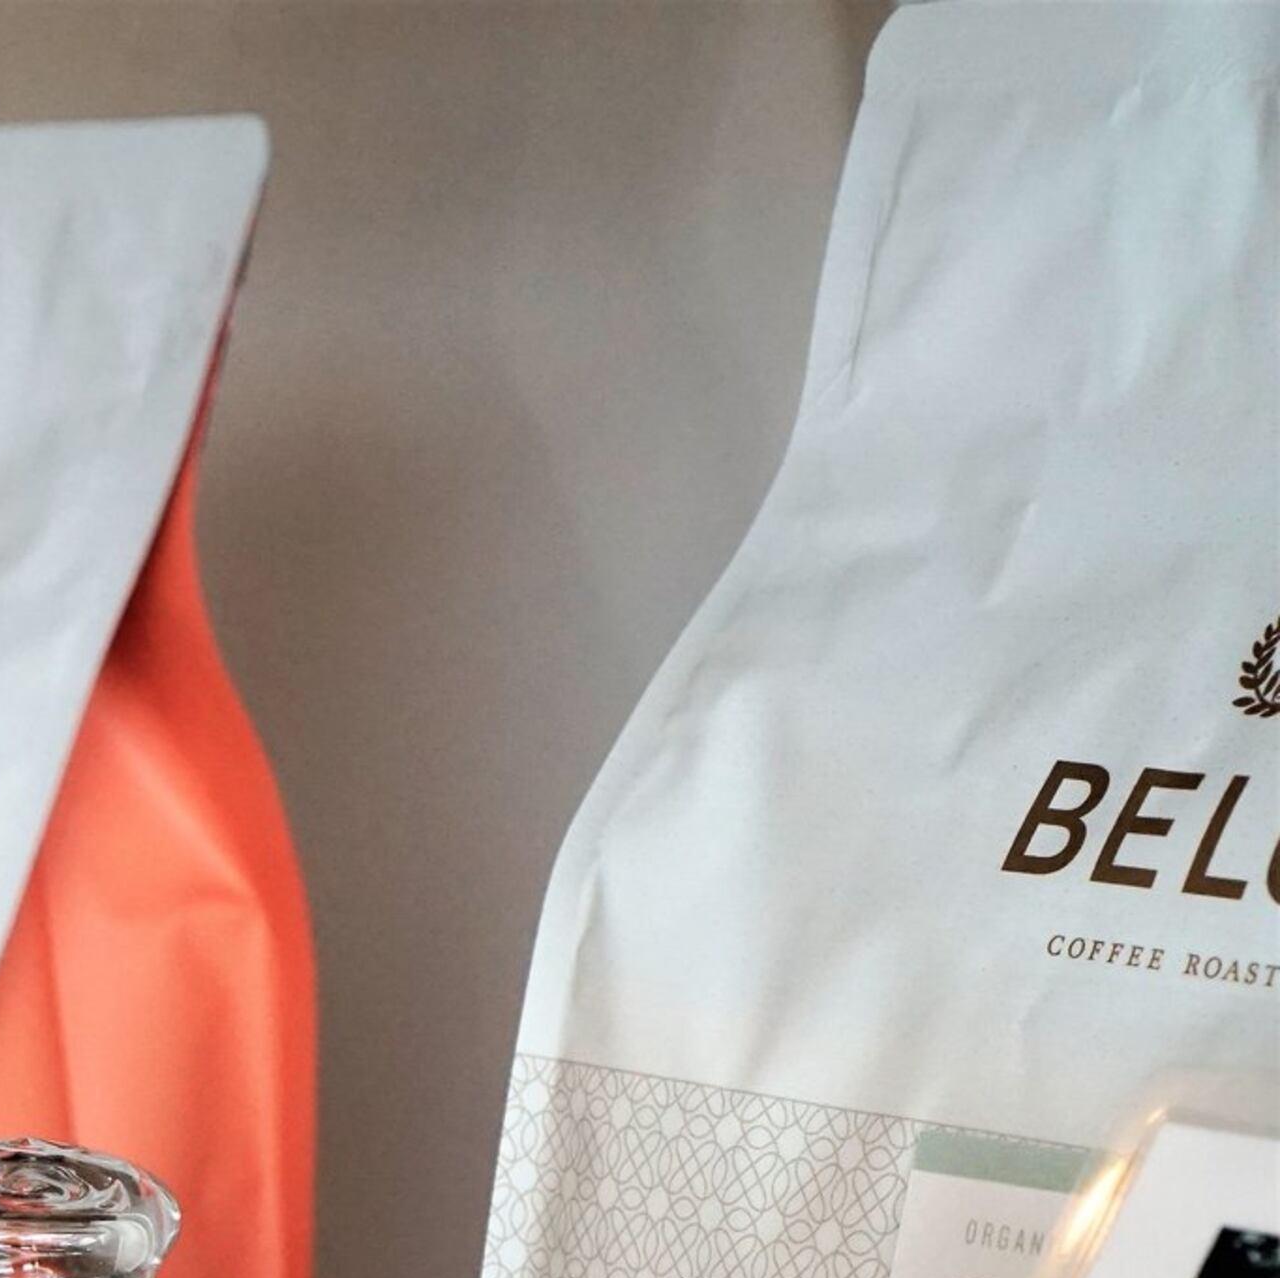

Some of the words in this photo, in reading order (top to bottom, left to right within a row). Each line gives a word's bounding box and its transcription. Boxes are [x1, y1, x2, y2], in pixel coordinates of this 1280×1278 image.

[1000, 759, 1280, 907] BEL
[1046, 934, 1166, 971] COFFEE
[1183, 952, 1280, 988] ROAST
[964, 1217, 1052, 1258] ORGAN
